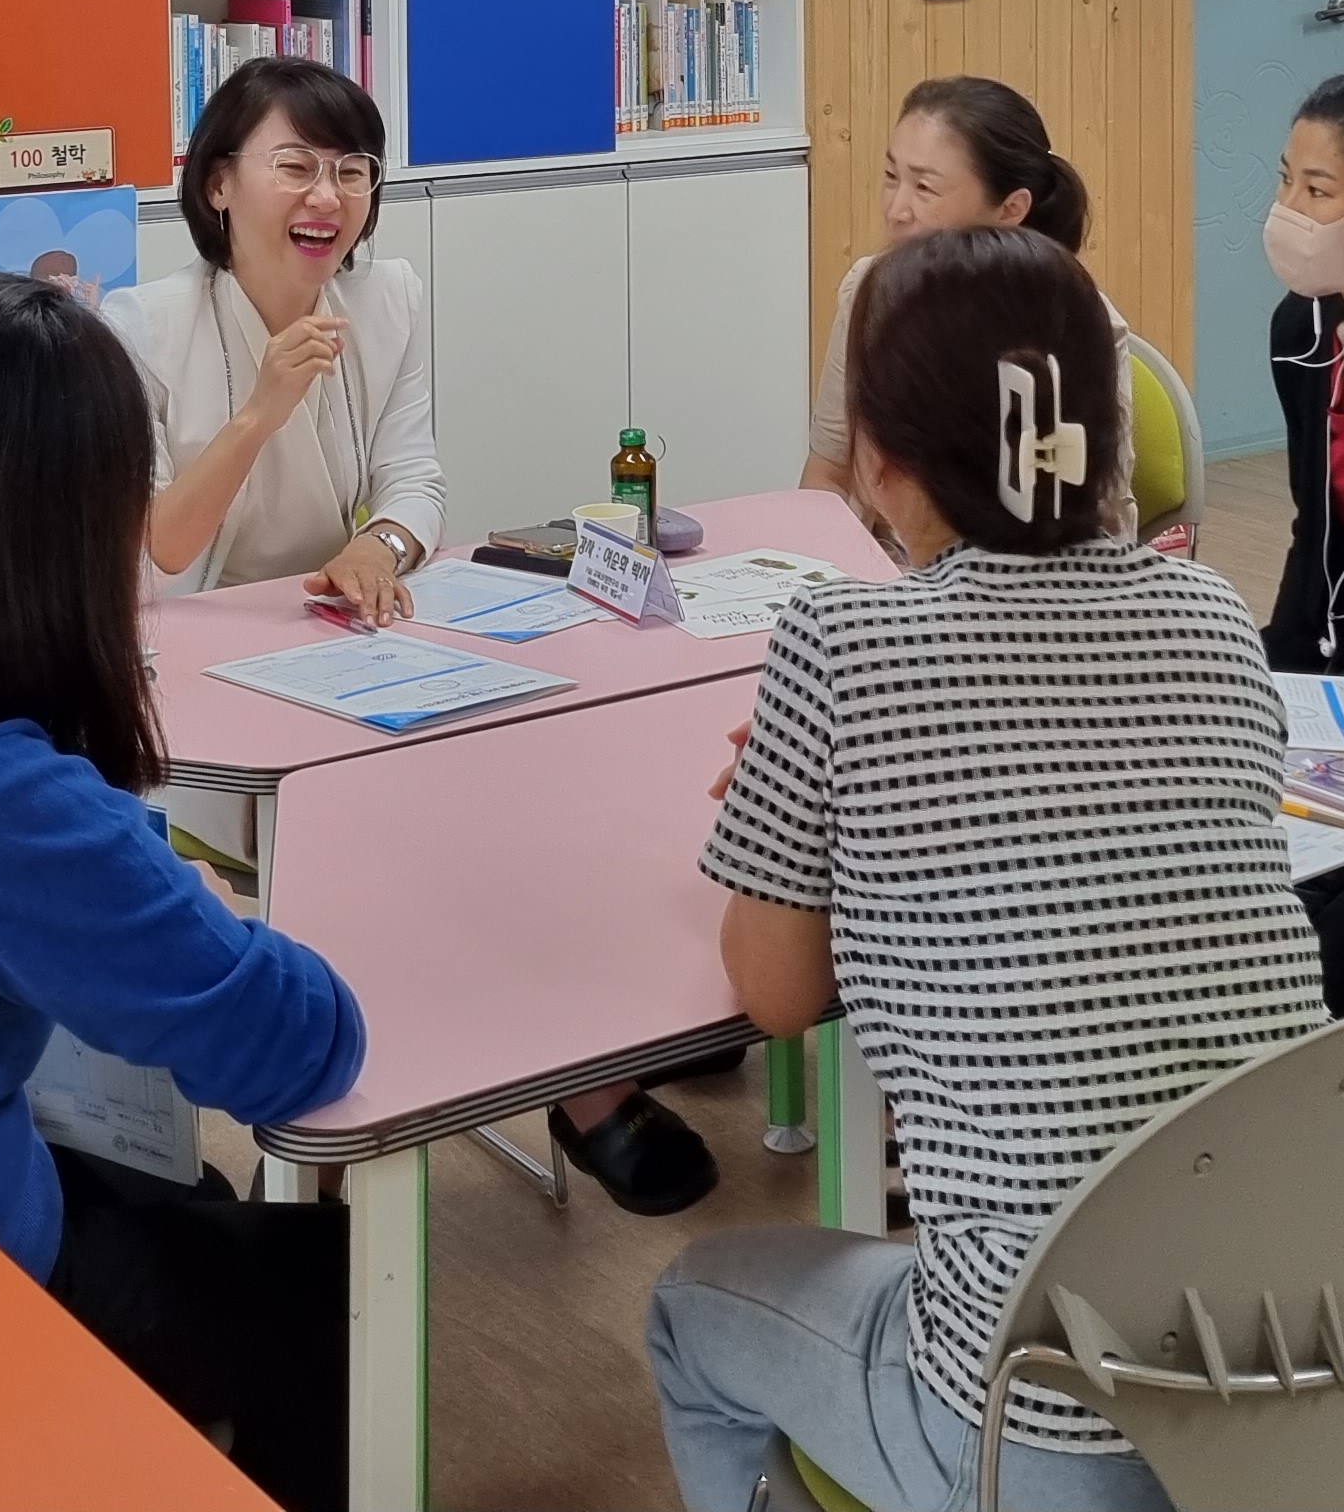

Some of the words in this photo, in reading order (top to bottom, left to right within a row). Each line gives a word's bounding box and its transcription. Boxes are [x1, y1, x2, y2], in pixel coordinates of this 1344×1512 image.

[10, 149, 42, 168] 100
[52, 144, 86, 166] 철학
[28, 171, 65, 179] Philosophy
[578, 535, 595, 558] 강사
[603, 548, 629, 575] 여순화
[631, 560, 650, 585] 박사
